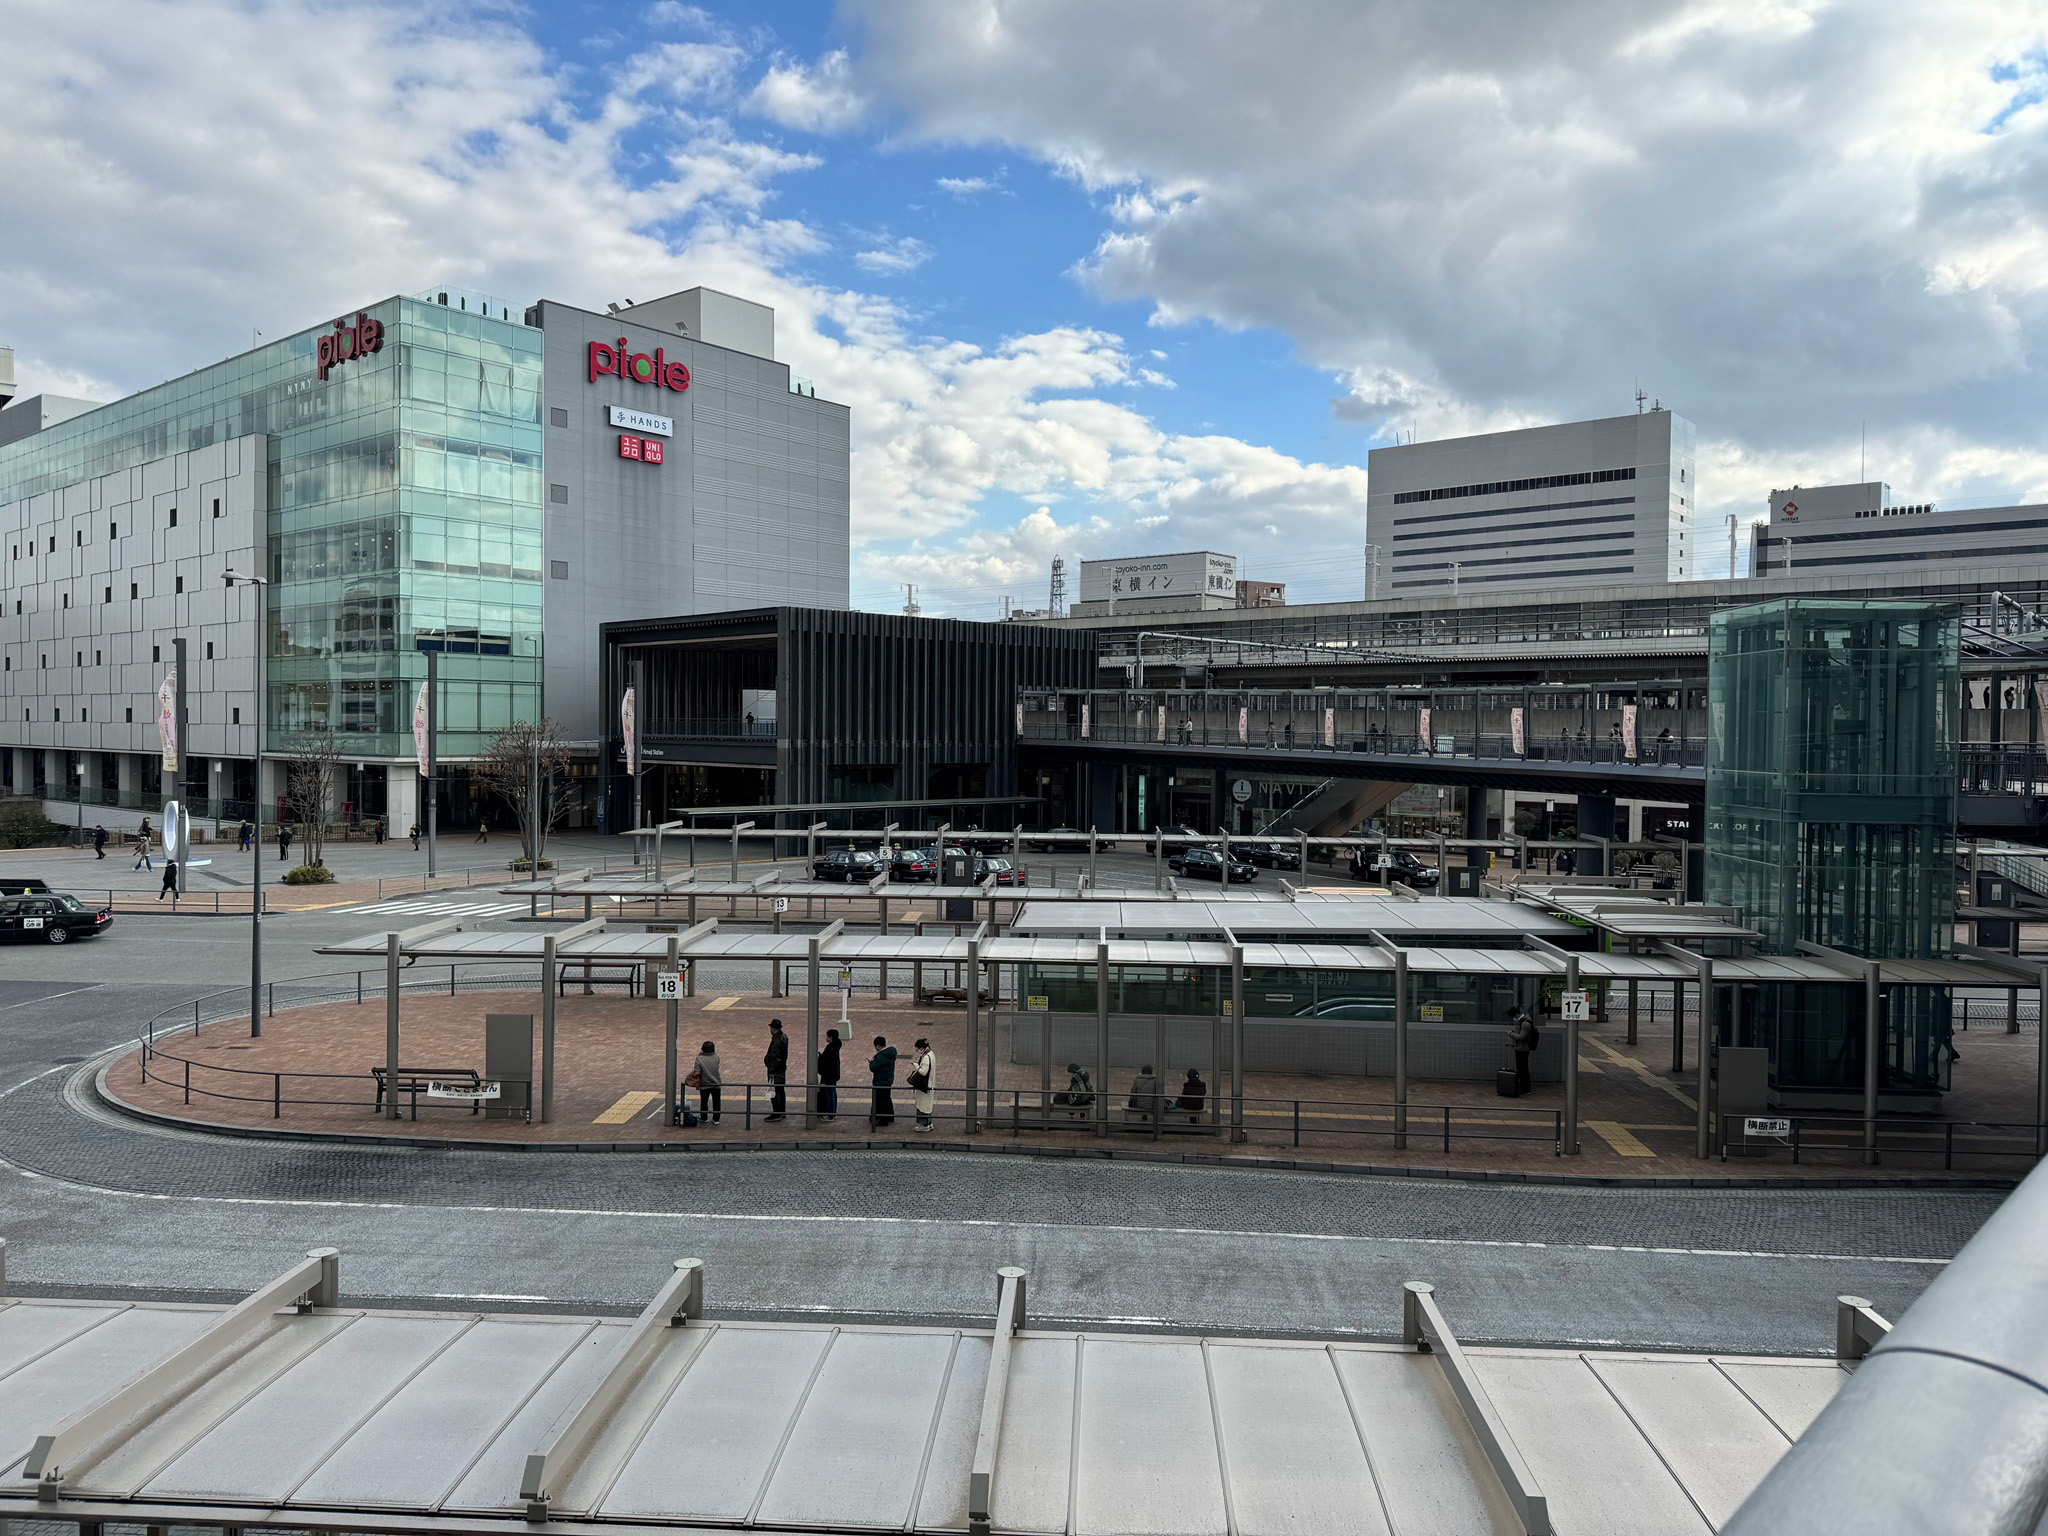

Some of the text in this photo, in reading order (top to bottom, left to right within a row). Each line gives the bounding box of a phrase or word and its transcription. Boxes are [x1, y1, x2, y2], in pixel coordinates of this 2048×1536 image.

[317, 311, 382, 381] piole
[589, 336, 690, 392] piole
[630, 414, 667, 430] HANDS
[623, 437, 638, 448] ユニ
[646, 442, 660, 452] UNI
[623, 447, 639, 457] クロ
[646, 451, 661, 461] QLO
[1112, 575, 1174, 594] 東横イン
[1207, 573, 1234, 591] 東横イン
[1259, 781, 1304, 795] NAVI
[882, 849, 888, 857] 5
[776, 898, 785, 908] 13
[660, 980, 676, 993] 18
[1565, 1000, 1582, 1013] 17
[1747, 1119, 1788, 1131] 横断禁止
